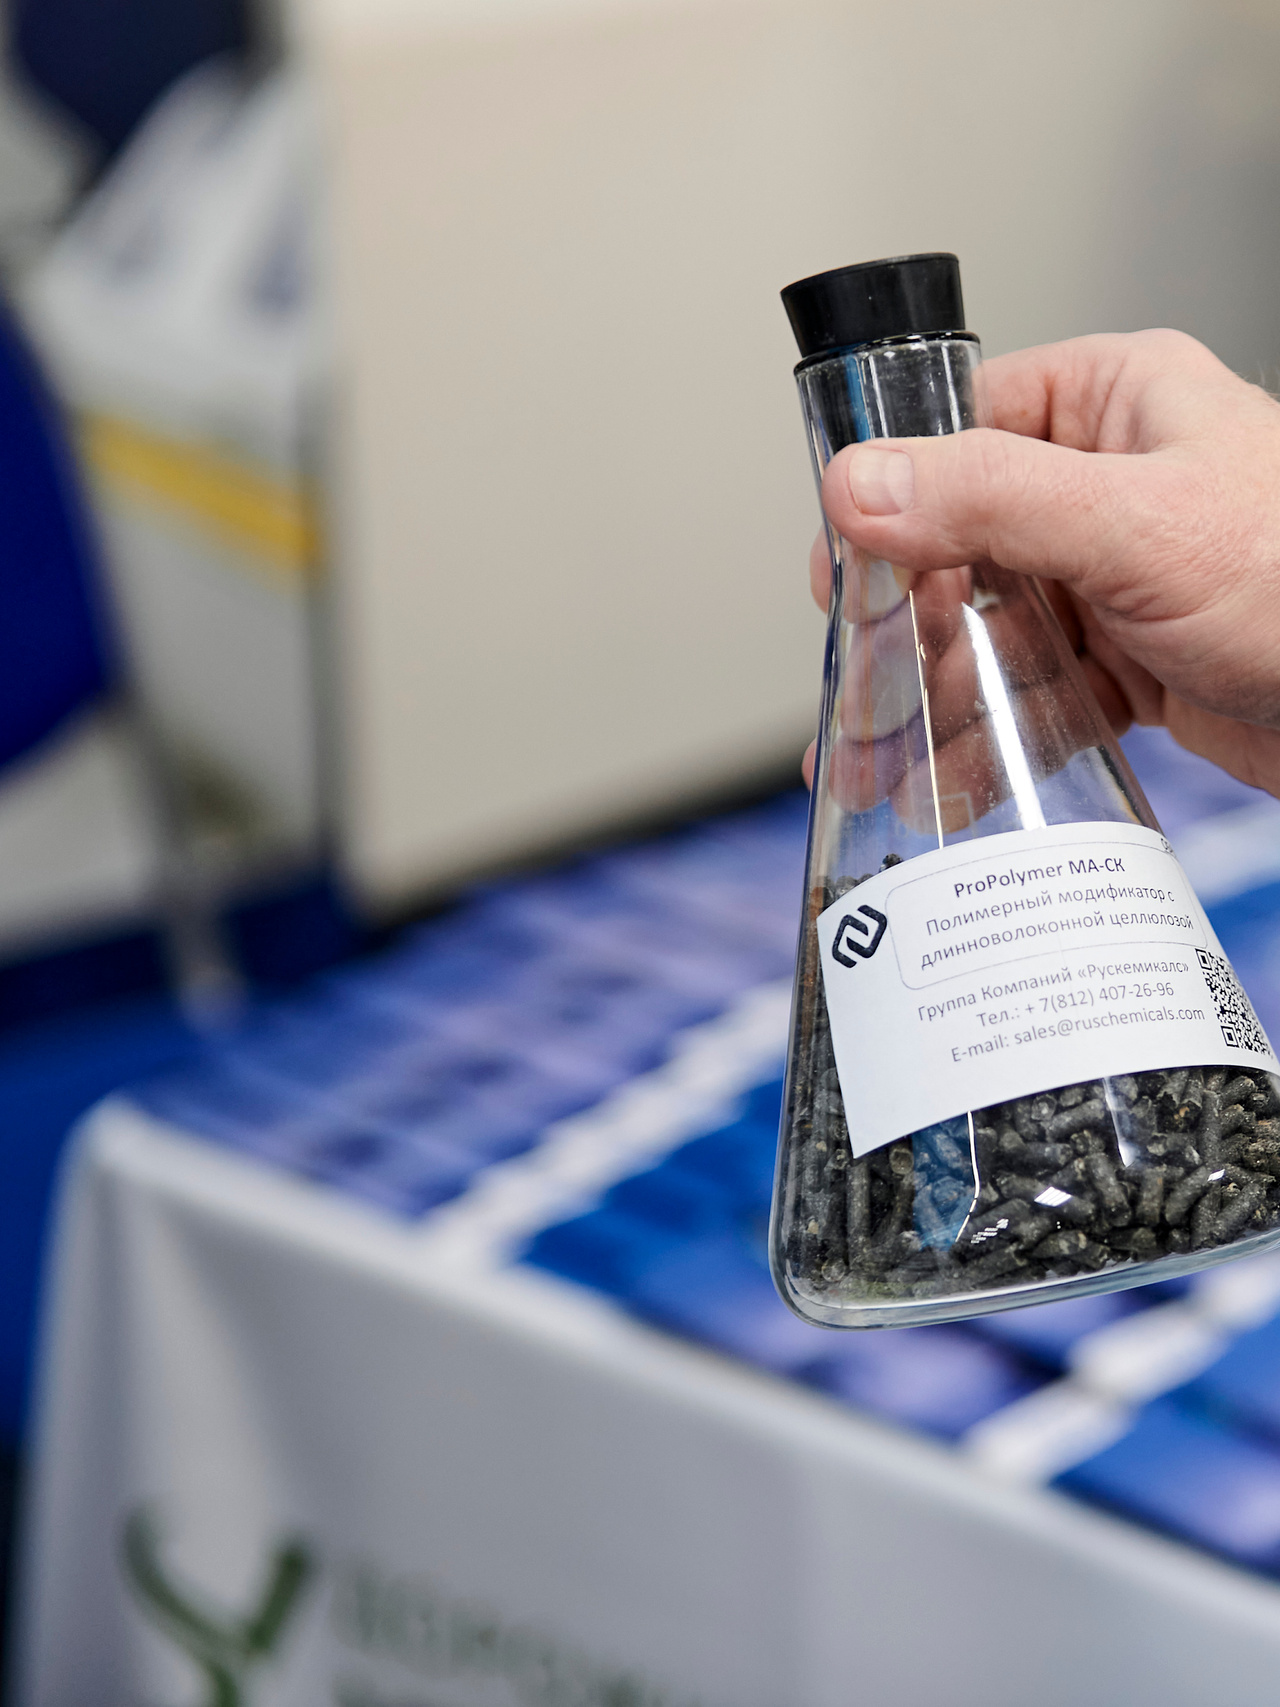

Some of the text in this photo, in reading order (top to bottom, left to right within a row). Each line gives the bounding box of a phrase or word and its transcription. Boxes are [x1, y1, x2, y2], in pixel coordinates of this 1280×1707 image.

[926, 890, 1052, 936] Полимерный
[1058, 883, 1165, 904] модификатор
[953, 868, 1063, 898] ProPolymer
[921, 911, 1194, 971] длинноволоконной целлюлозой
[918, 961, 1189, 1021] Группа Компаний «Рускемикалс»
[976, 1007, 1020, 1027] Тел.:
[1038, 988, 1094, 1013] 7(812)
[1099, 982, 1174, 1001] 407-26-96
[951, 1006, 1205, 1062] E-mail: sales@ruschemicals.com
